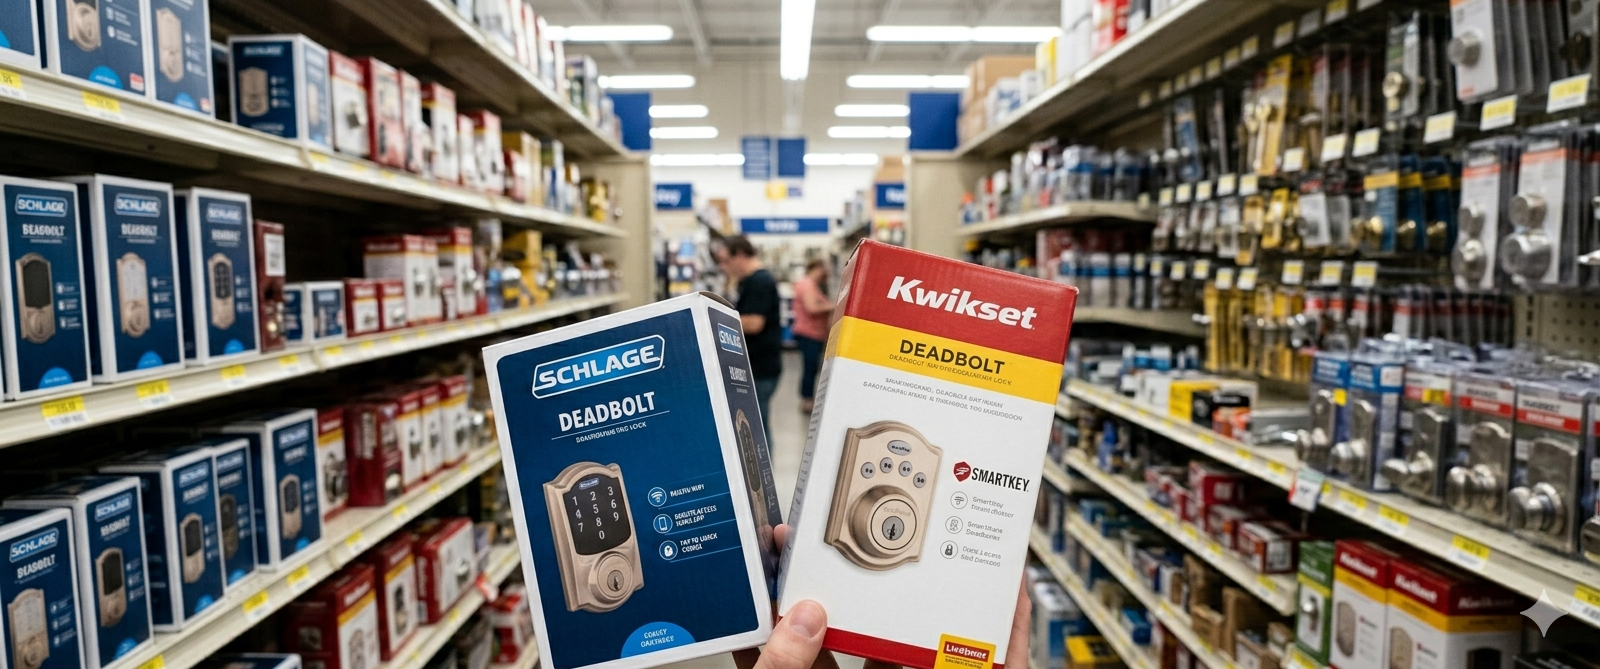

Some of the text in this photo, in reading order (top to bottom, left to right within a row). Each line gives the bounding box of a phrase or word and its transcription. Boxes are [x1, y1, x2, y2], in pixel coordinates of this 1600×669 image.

[887, 275, 1037, 330] Kwikset
[537, 344, 662, 391] SCHLAGE
[899, 339, 1006, 375] DEADBOLT
[558, 391, 656, 432] DEADBOLT
[971, 467, 1030, 492] SMARTKEY
[572, 486, 614, 506] 1 2 3
[592, 504, 599, 514] 5
[611, 499, 617, 509] 6
[577, 511, 619, 532] 7 8 9
[598, 530, 605, 540] 0
